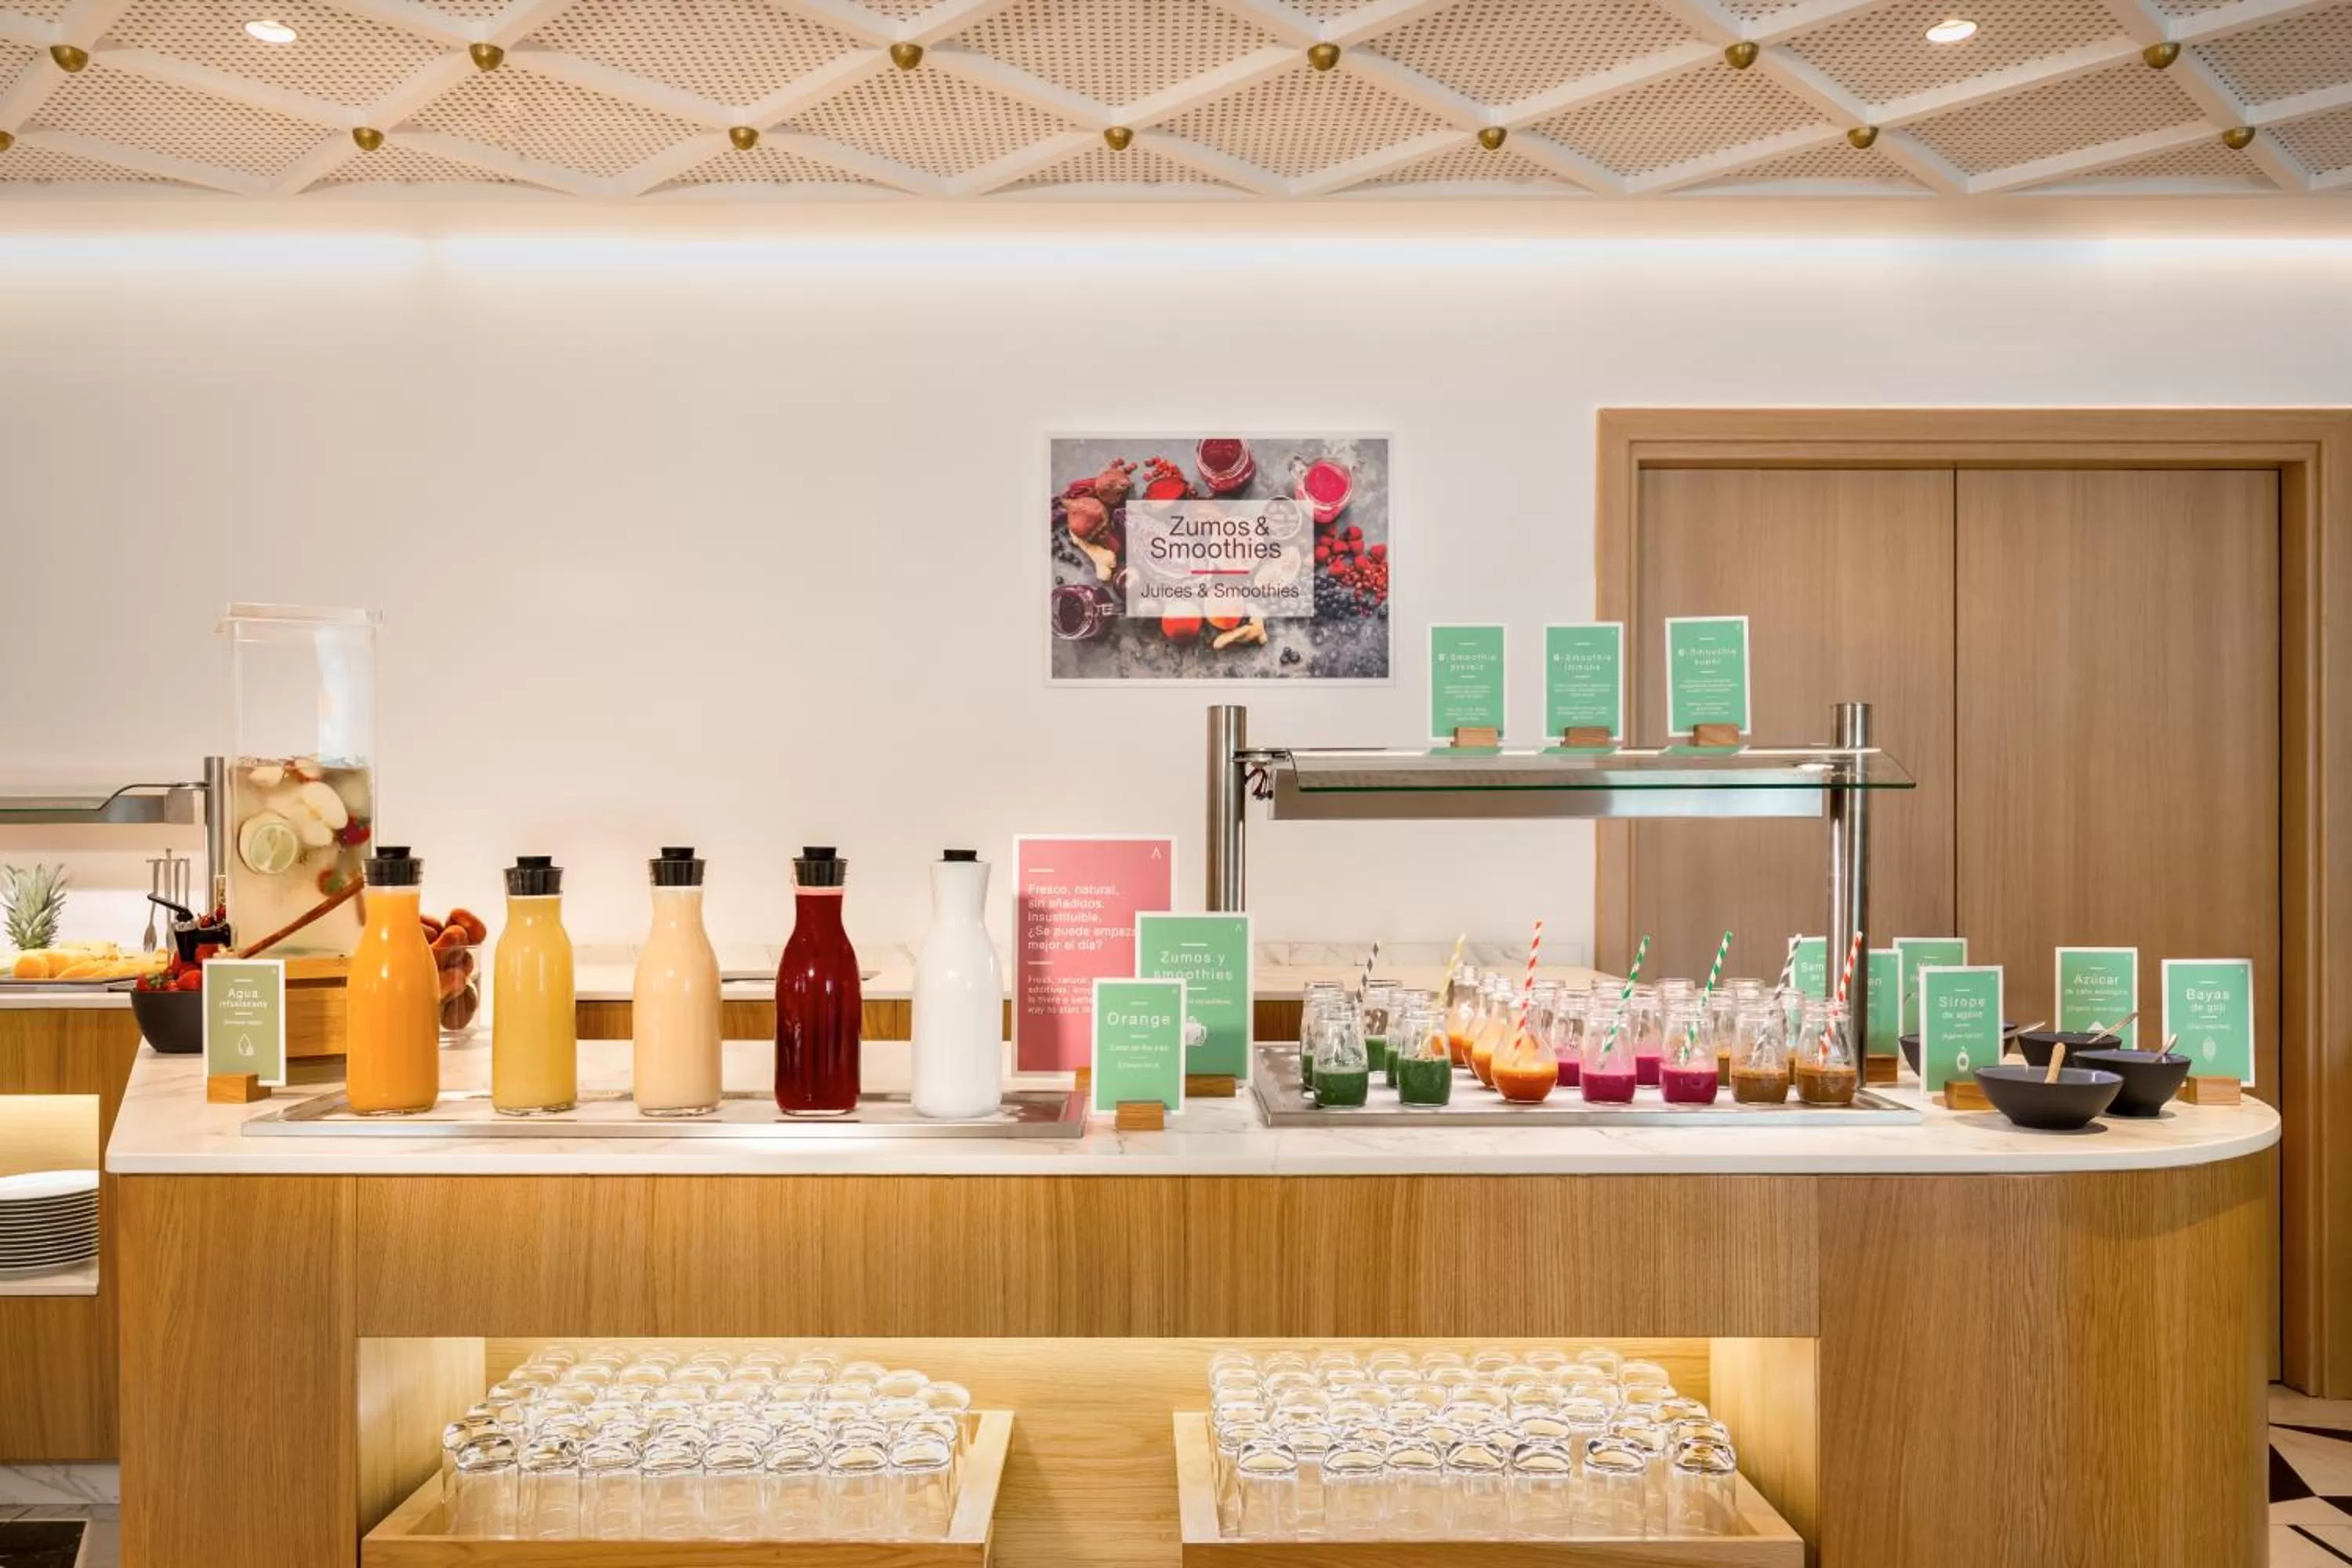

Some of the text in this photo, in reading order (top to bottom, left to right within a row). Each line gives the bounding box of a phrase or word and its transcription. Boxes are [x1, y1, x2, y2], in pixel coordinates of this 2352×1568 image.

[1170, 516, 1270, 537] Zumos &
[1150, 537, 1283, 559] Smoothies
[1141, 583, 1300, 598] Juices & Smoothies
[1028, 884, 1120, 896] Fresco, natural,
[1028, 898, 1045, 909] sin
[1028, 926, 1136, 938] ¿Se puede empez
[1028, 941, 1062, 953] mejor
[1063, 940, 1074, 950] el
[1160, 951, 1226, 967] Zumos y
[227, 987, 258, 1000] Agua
[2186, 988, 2230, 1004] Bayas
[1938, 995, 1986, 1009] Sirope
[1106, 1011, 1171, 1029] Orange
